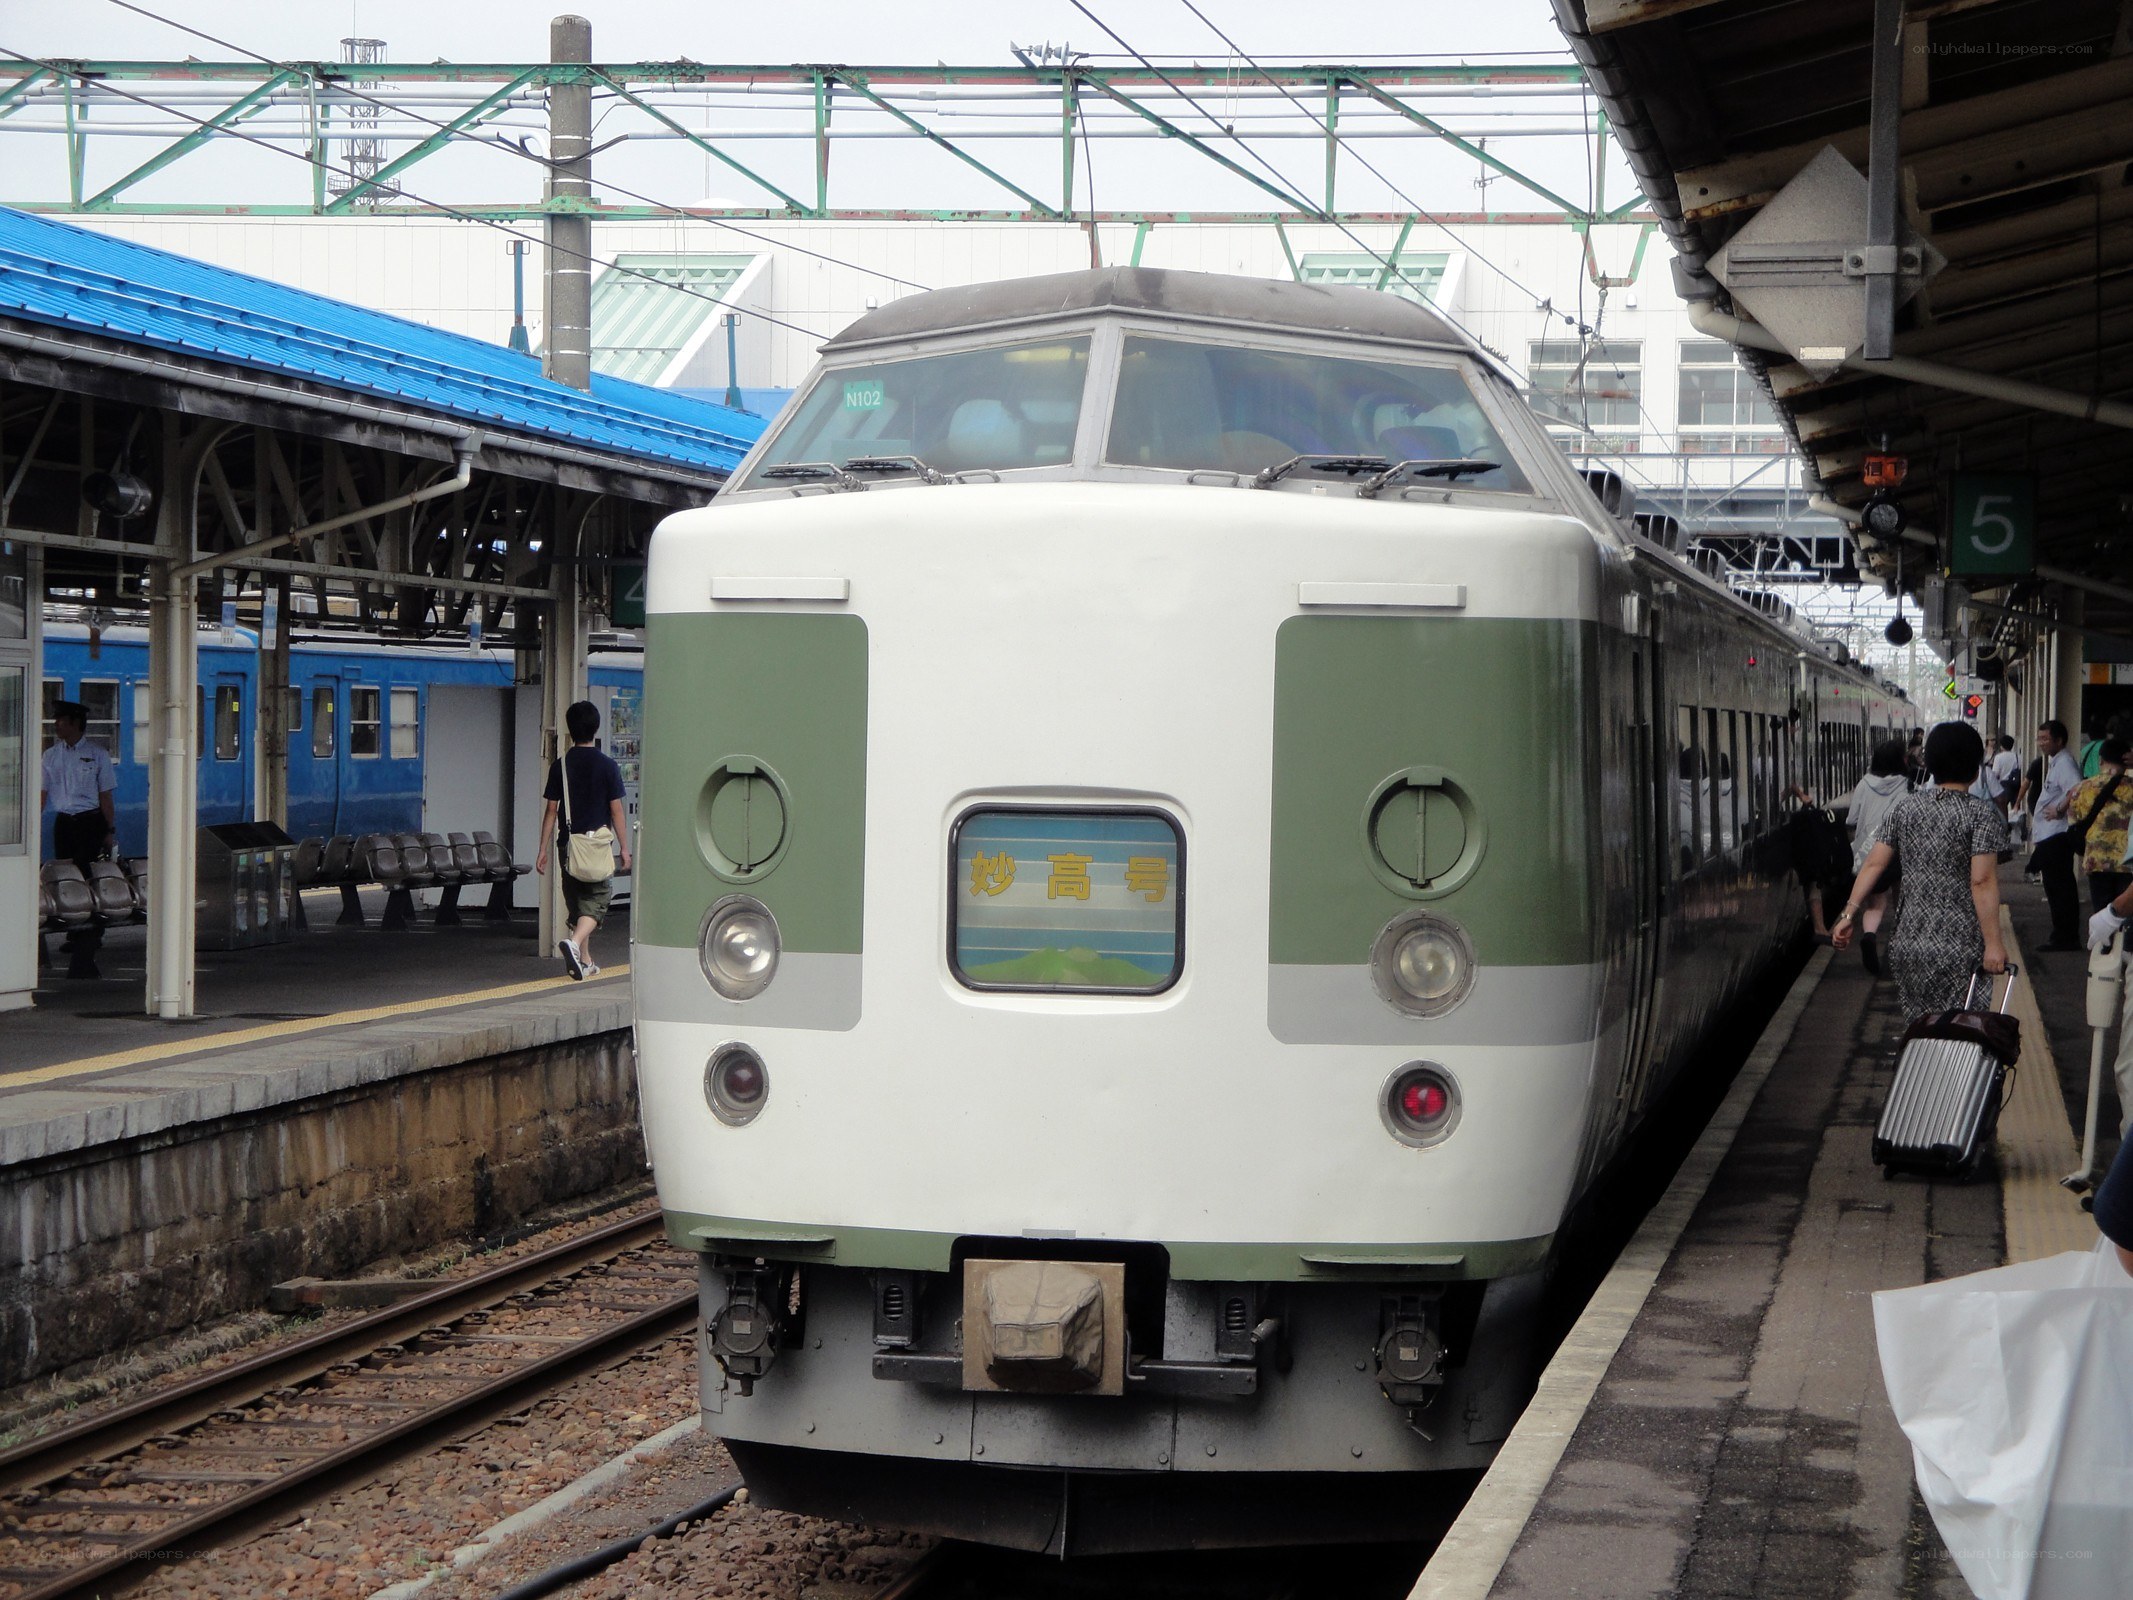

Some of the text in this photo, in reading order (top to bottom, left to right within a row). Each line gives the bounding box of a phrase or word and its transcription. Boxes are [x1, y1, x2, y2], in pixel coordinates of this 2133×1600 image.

[846, 390, 881, 407] N102
[1970, 495, 2015, 554] 5
[624, 570, 647, 612] 4
[968, 850, 1170, 903] 妙高号
